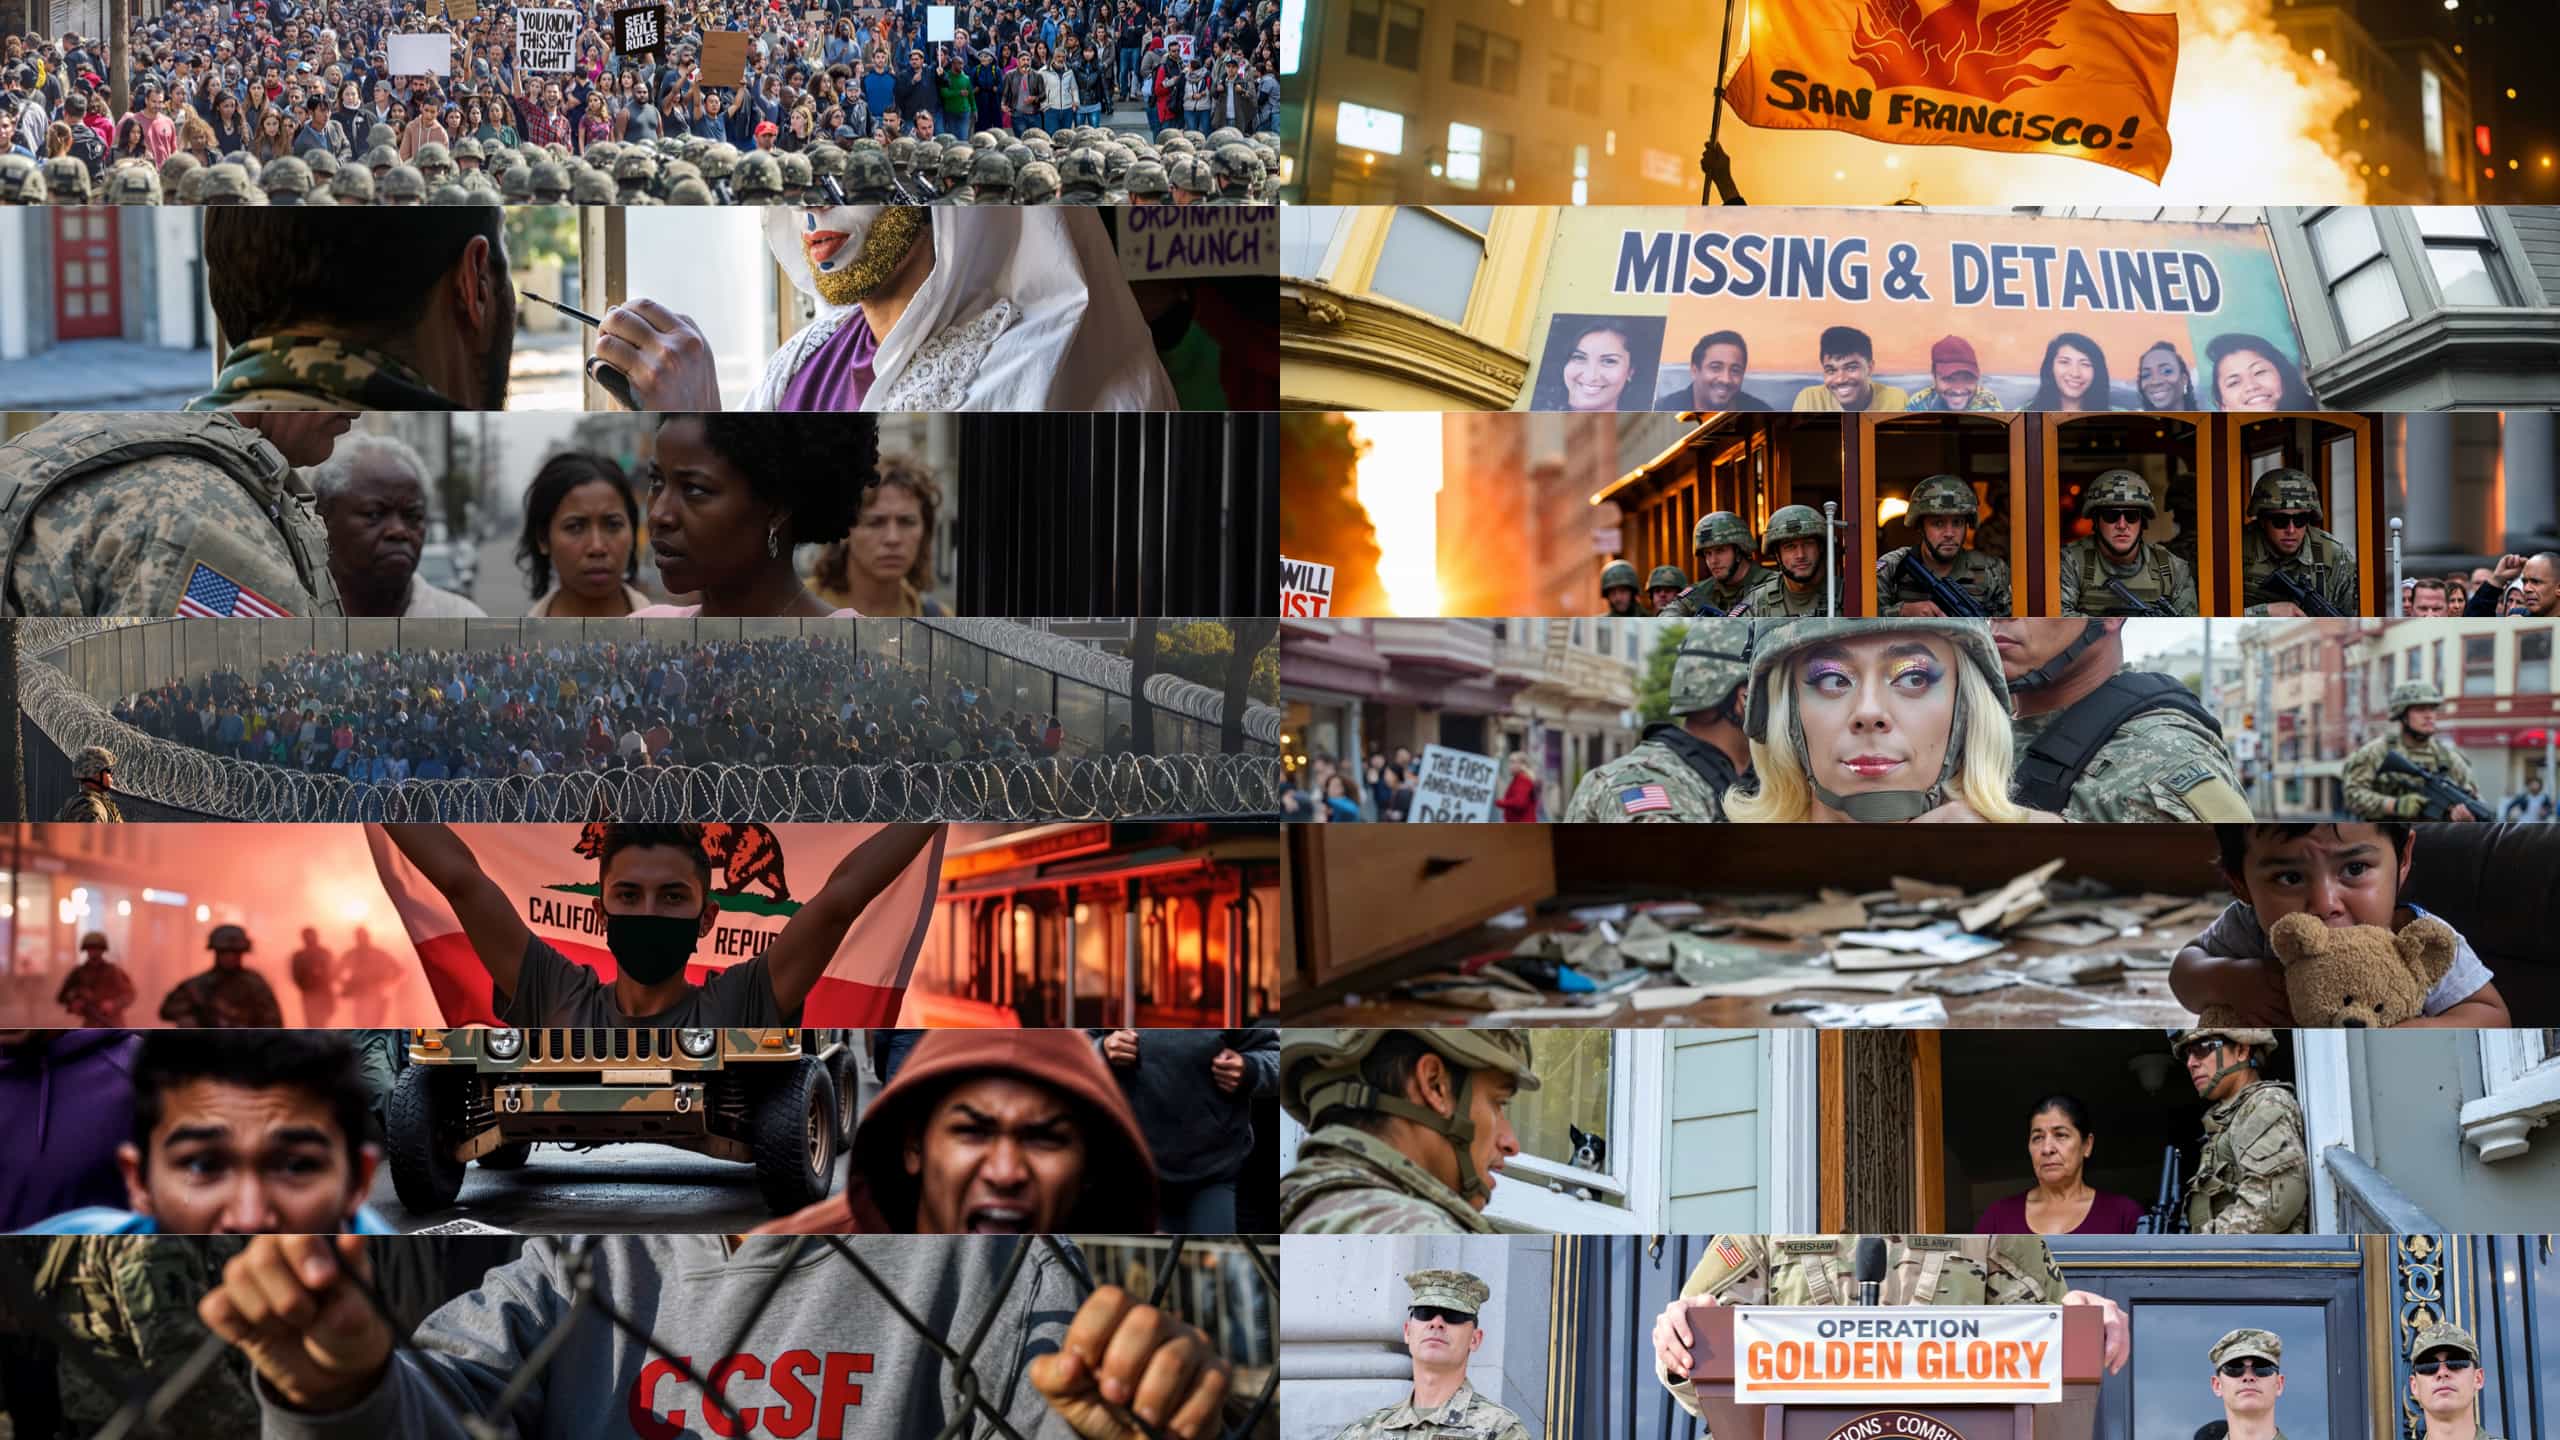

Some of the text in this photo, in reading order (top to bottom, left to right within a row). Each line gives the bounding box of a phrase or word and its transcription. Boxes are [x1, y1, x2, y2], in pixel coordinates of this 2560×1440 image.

[625, 10, 655, 29] SELF
[626, 20, 657, 39] RULE
[520, 32, 574, 50] THIS ISN'T
[625, 32, 658, 52] RULES
[520, 49, 571, 69] RIGHT
[1766, 70, 1872, 120] SAN
[1128, 206, 1275, 232] ORDINATION
[1146, 227, 1260, 272] LAUNCH
[1613, 230, 2221, 313] MISSING & DETAINED
[1280, 561, 1329, 596] WILL
[1280, 592, 1327, 617] IST
[1431, 753, 1493, 784] THE FIRST
[1787, 1241, 1834, 1251] KERSHAW
[1817, 1319, 1979, 1338] OPERATION
[1747, 1340, 2049, 1381] GOLDEN GLORY
[628, 1349, 875, 1440] CCSF
